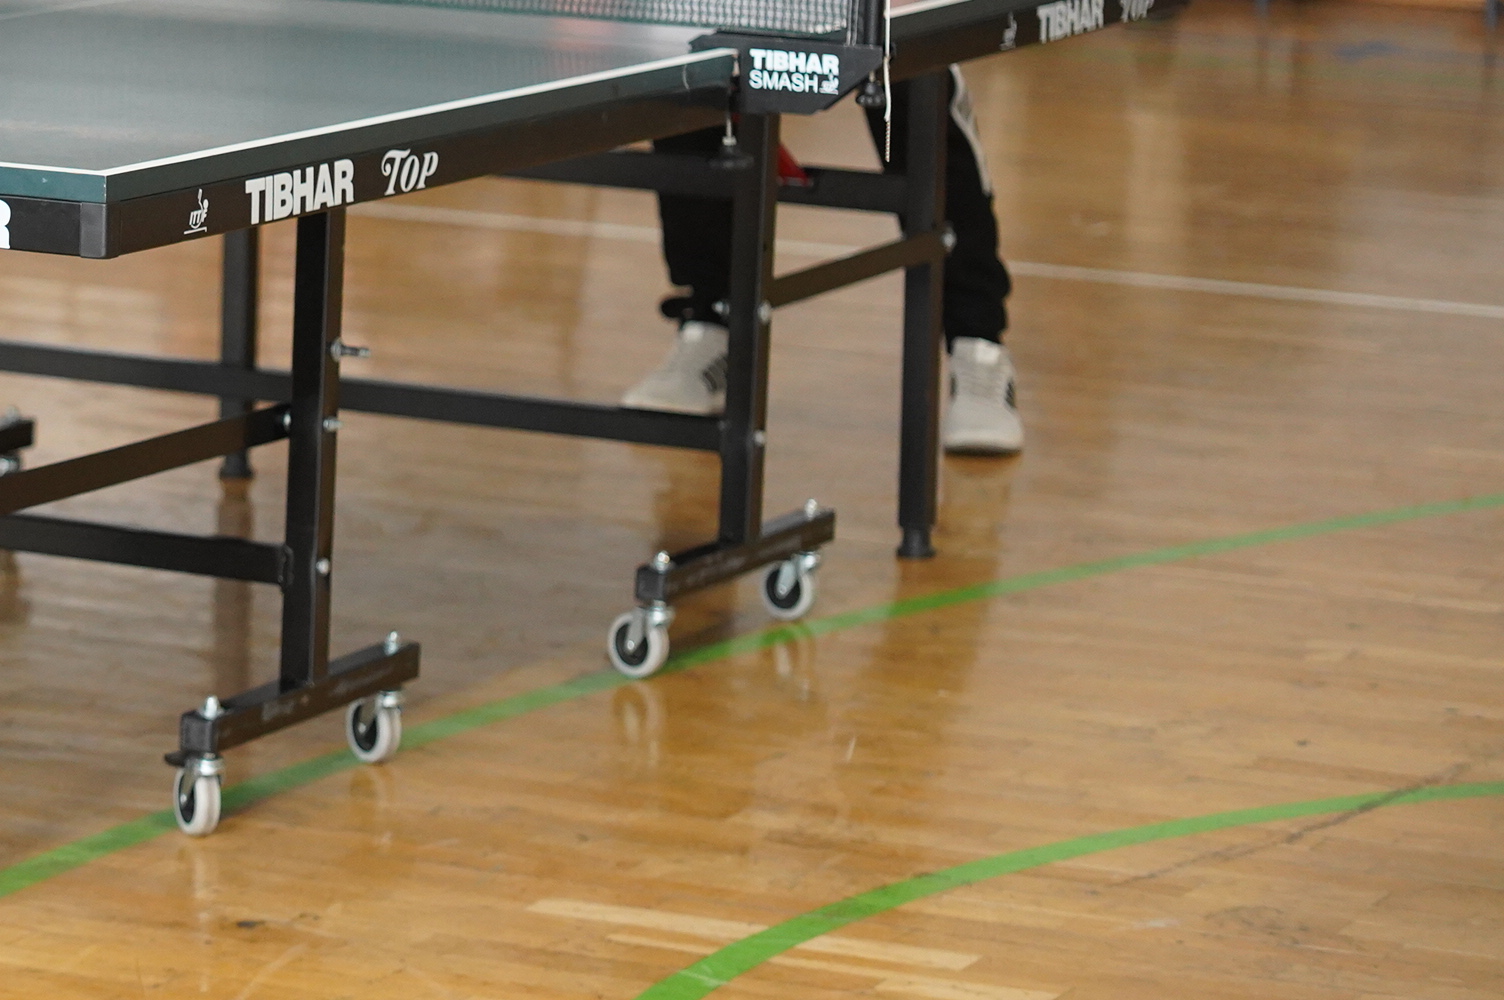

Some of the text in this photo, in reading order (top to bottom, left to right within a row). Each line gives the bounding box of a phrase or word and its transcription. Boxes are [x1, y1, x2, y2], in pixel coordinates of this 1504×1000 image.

[749, 49, 839, 76] TIBHAR
[749, 70, 819, 93] SMASH
[245, 158, 355, 226] TIBHAR
